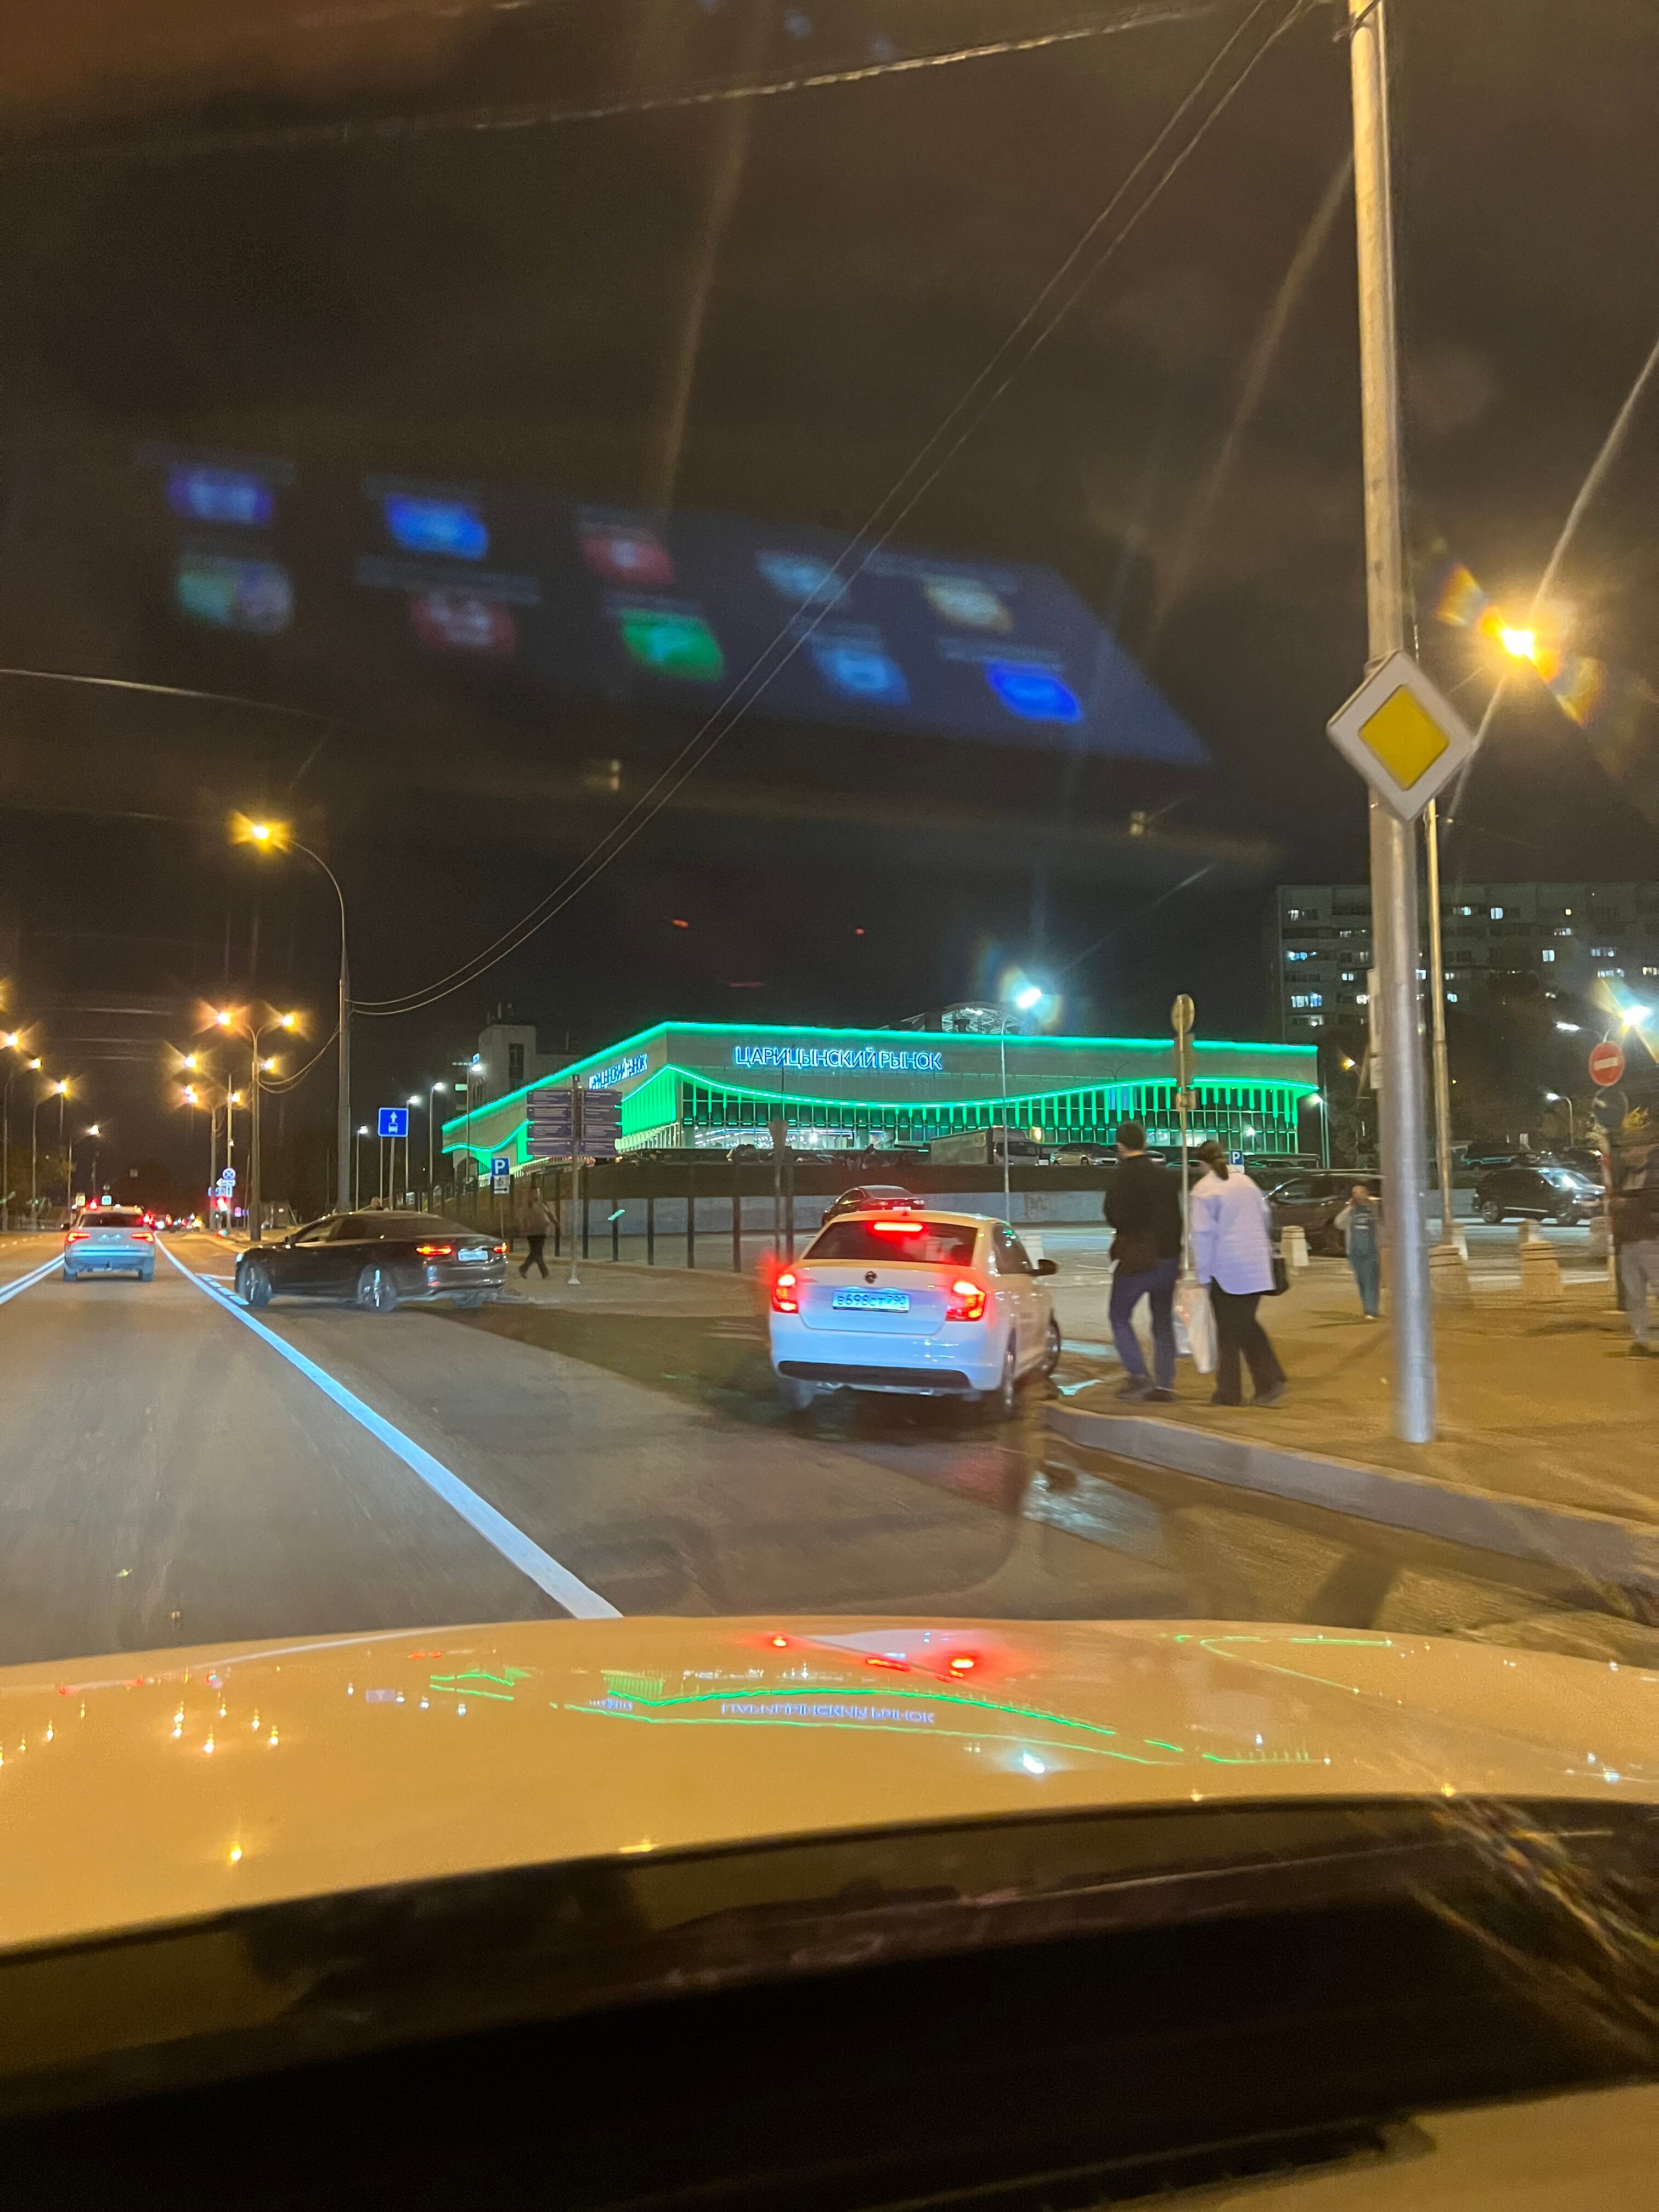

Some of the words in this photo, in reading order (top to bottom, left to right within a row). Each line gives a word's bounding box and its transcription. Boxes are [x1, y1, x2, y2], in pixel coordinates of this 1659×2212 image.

[735, 1046, 877, 1069] ЦАРИЦЫНСКИЙ
[879, 1051, 943, 1070] РЫНОК
[1232, 1151, 1240, 1164] P
[494, 1159, 505, 1175] P
